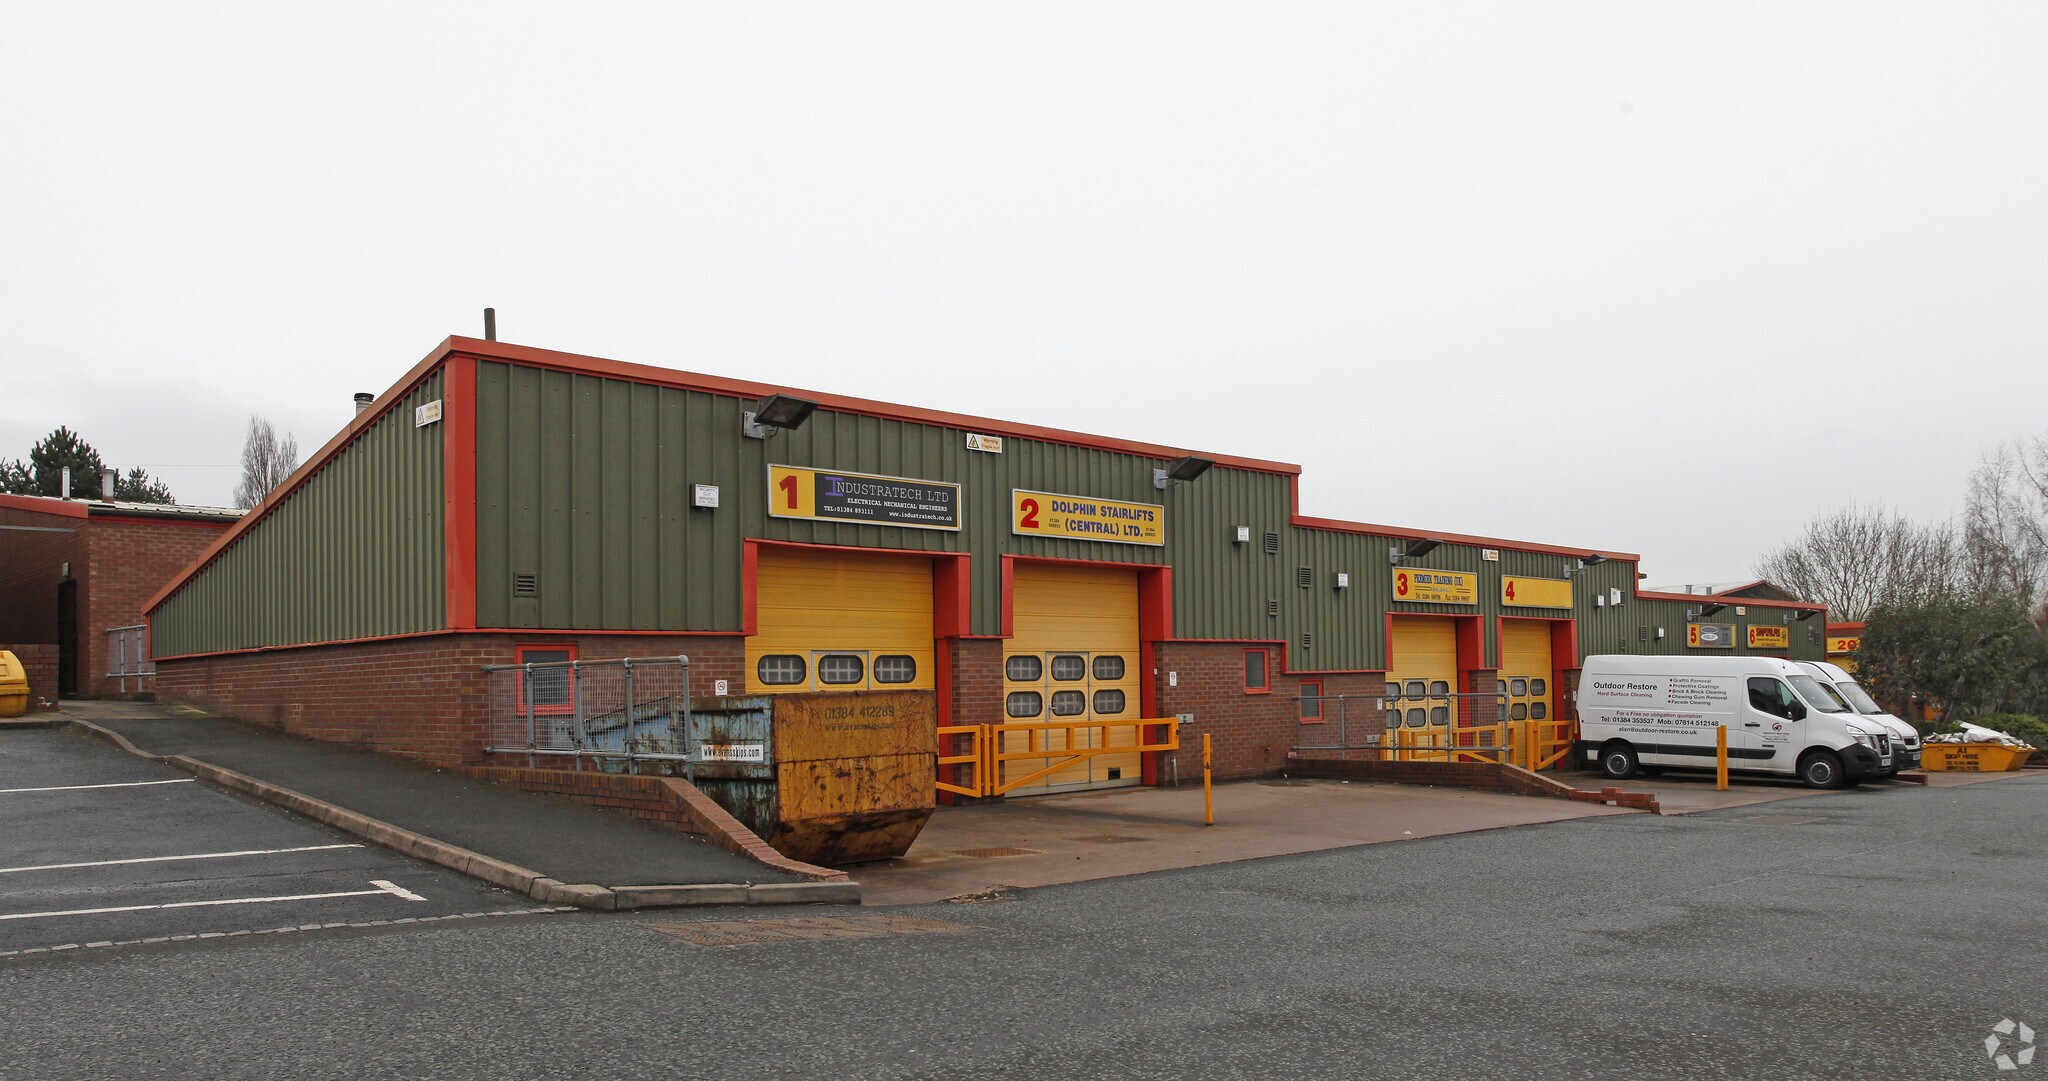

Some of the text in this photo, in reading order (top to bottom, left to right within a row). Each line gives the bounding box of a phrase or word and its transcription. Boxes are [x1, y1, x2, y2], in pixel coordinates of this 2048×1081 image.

[779, 475, 798, 509] 1
[825, 476, 949, 503] INDUSTRATECH LTD
[847, 498, 948, 512] ELECTRICAL MECHANICAL ENGINEERS
[1051, 500, 1154, 522] DOLPHIN STAIRLIFTS
[888, 511, 953, 521] www.industratech.co.uk
[1020, 498, 1039, 529] 2
[1065, 517, 1143, 537] (CENTRAL) LTD.
[1397, 573, 1409, 596] 3
[1505, 581, 1515, 601] 4
[1690, 627, 1697, 644] 5
[1750, 628, 1755, 644] 6
[1837, 639, 1857, 650] 20
[1593, 682, 1658, 691] Outdoor Restore
[824, 705, 895, 719] 01384 412289
[1618, 727, 1698, 735] alan@outdoor-restore.co.uk
[703, 746, 760, 759] www.evansskips.com
